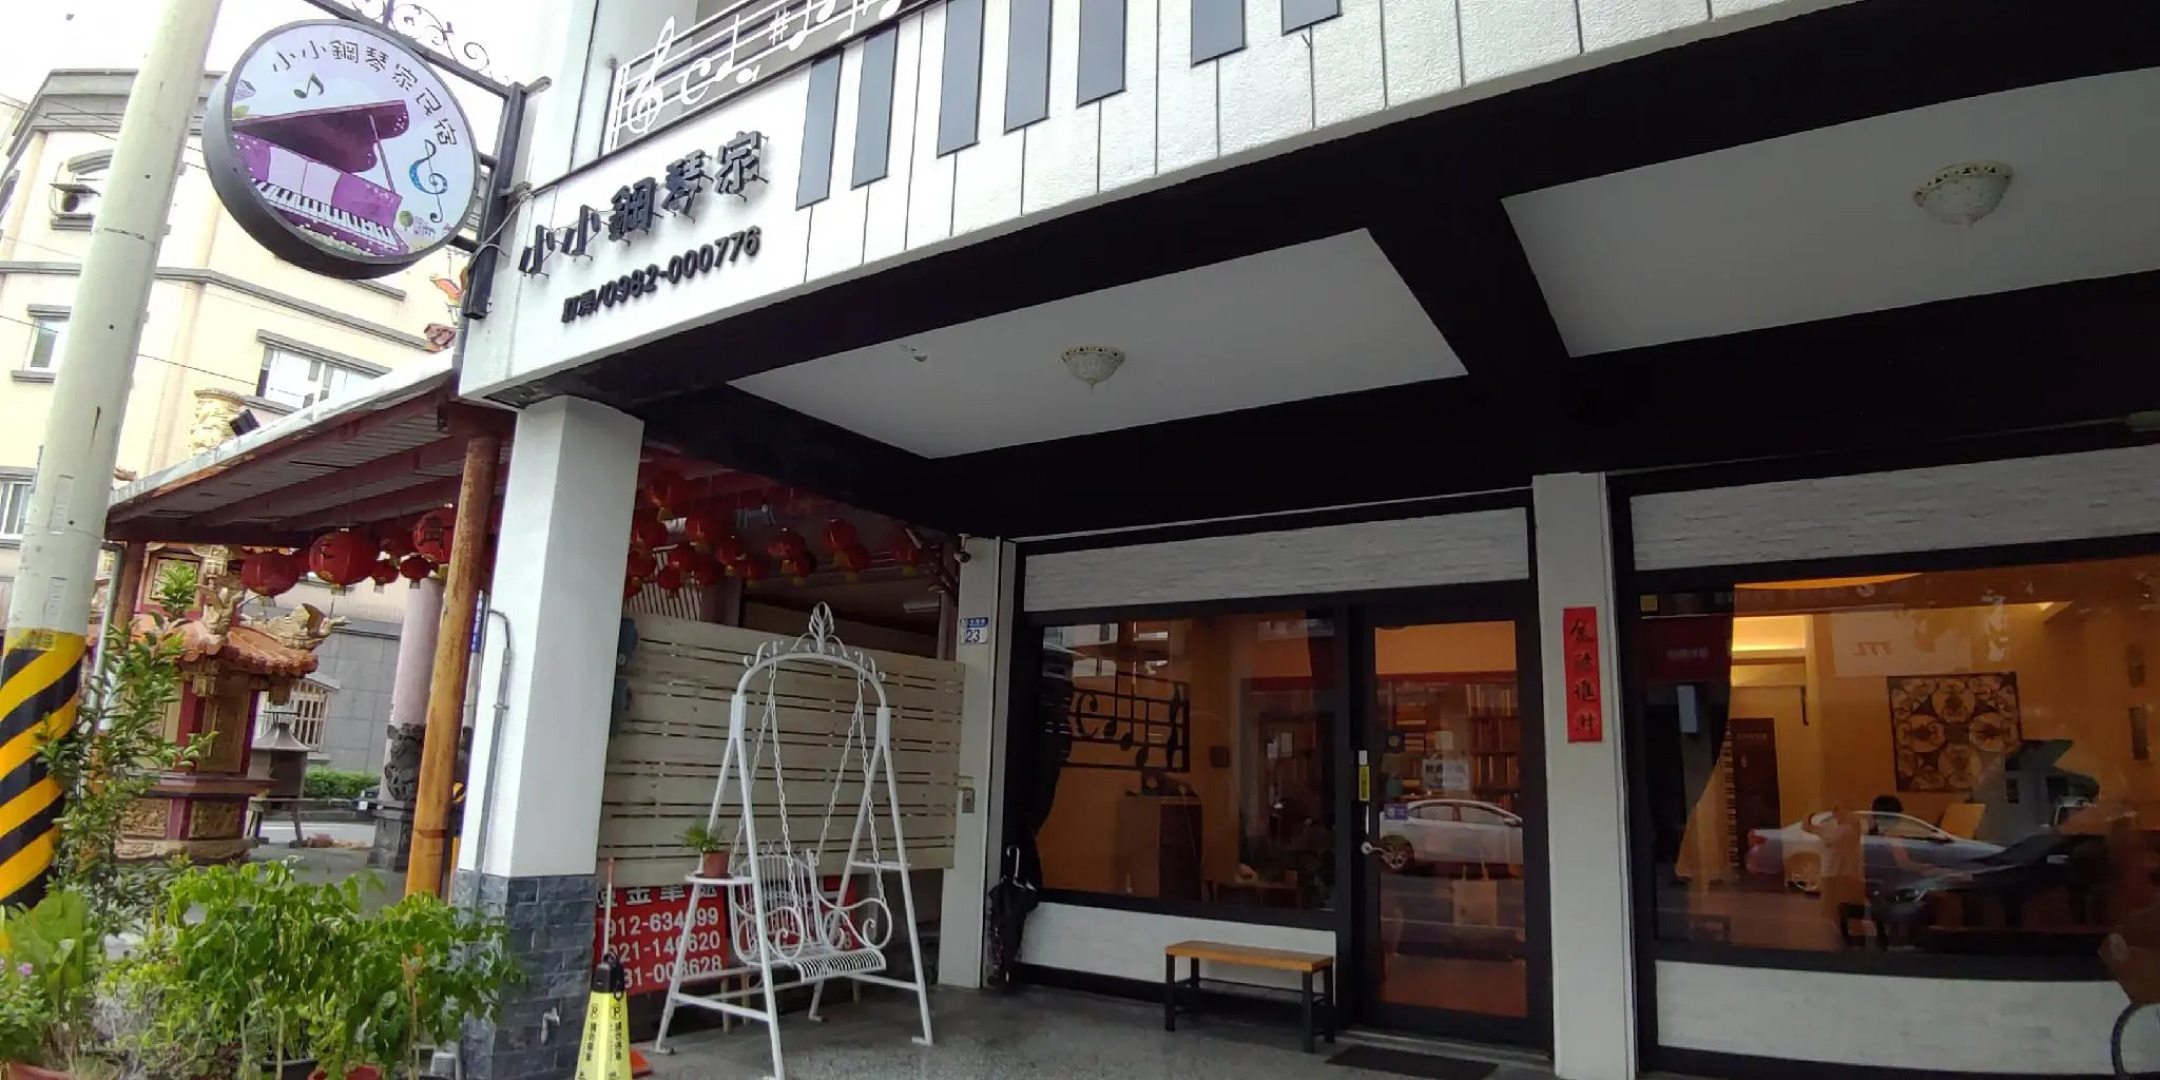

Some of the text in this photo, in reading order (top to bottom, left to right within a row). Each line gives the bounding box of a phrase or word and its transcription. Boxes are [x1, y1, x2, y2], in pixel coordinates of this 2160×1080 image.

[273, 40, 457, 145] 小小鋼琴家民宿
[519, 131, 762, 273] 小小鋼琴家
[965, 629, 980, 643] 23
